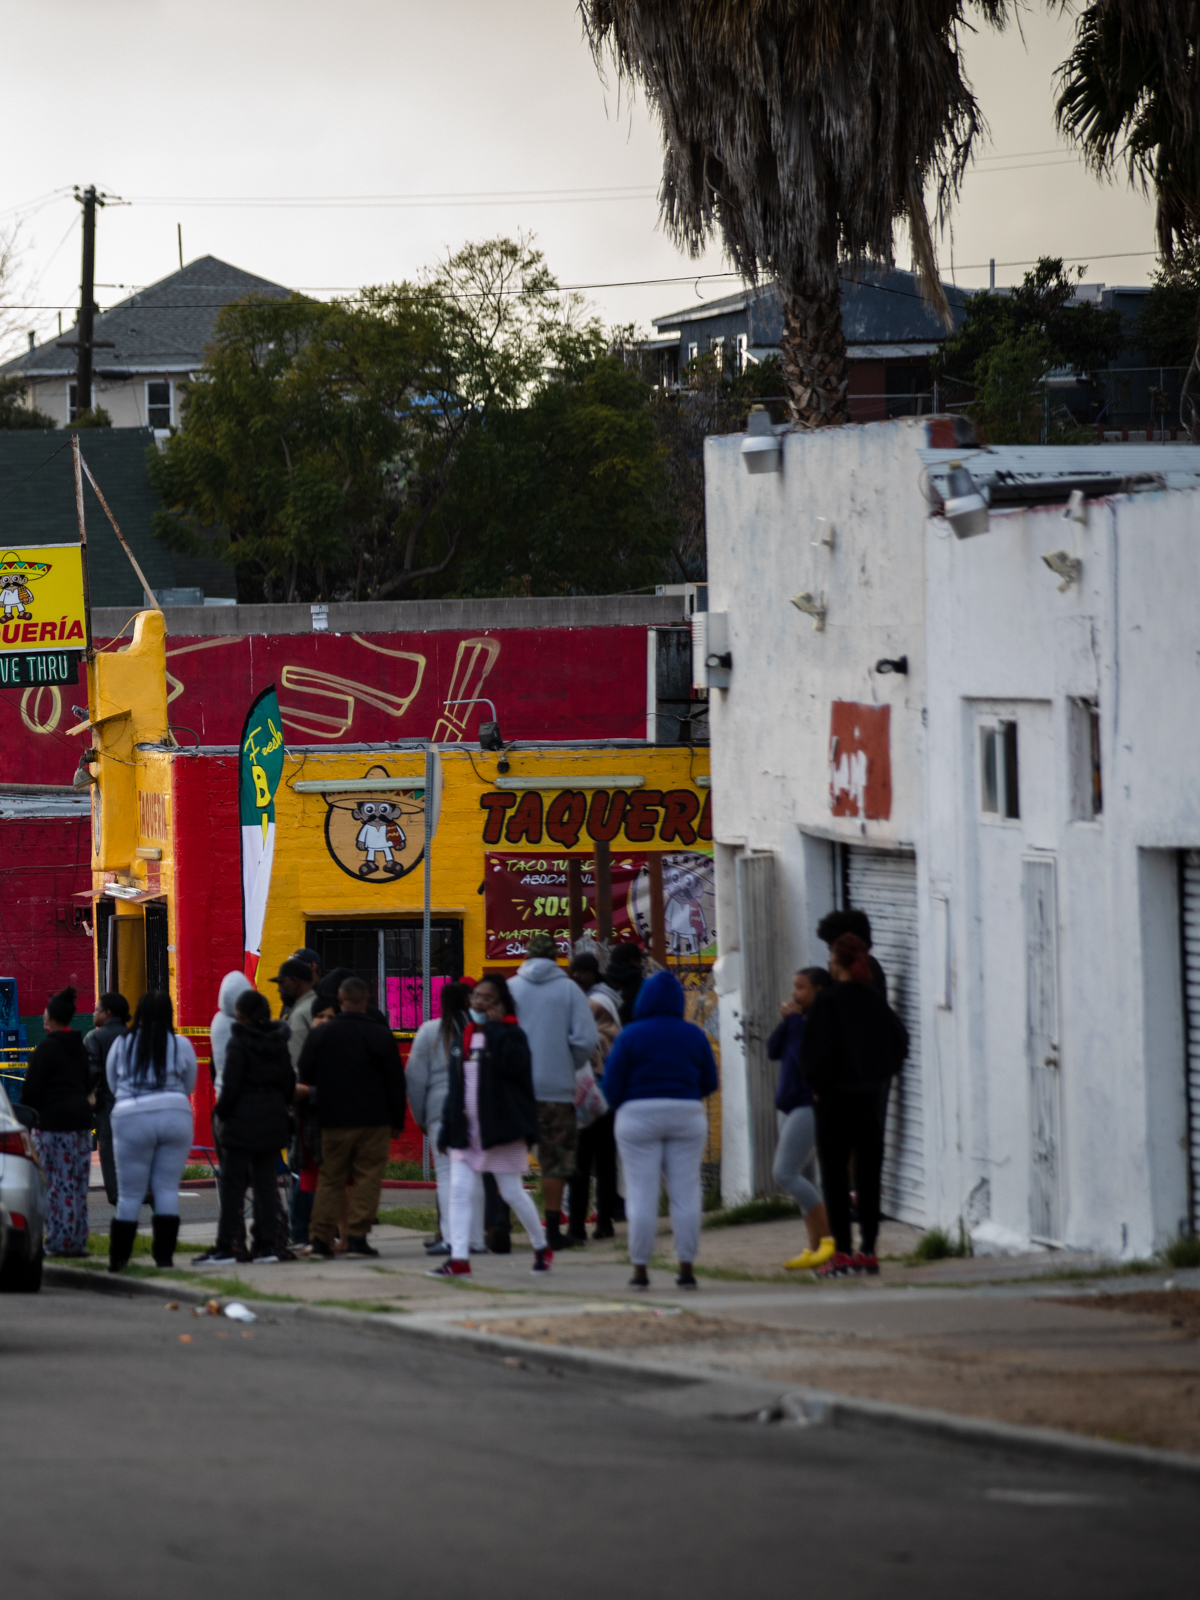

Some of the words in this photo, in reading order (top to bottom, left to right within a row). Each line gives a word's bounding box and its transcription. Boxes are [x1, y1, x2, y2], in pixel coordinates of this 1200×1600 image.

[26, 654, 69, 681] THRU
[243, 718, 283, 765] Fresh
[481, 789, 713, 849] TAQUERI
[505, 859, 547, 872] TACO
[506, 941, 528, 955] SÓL
